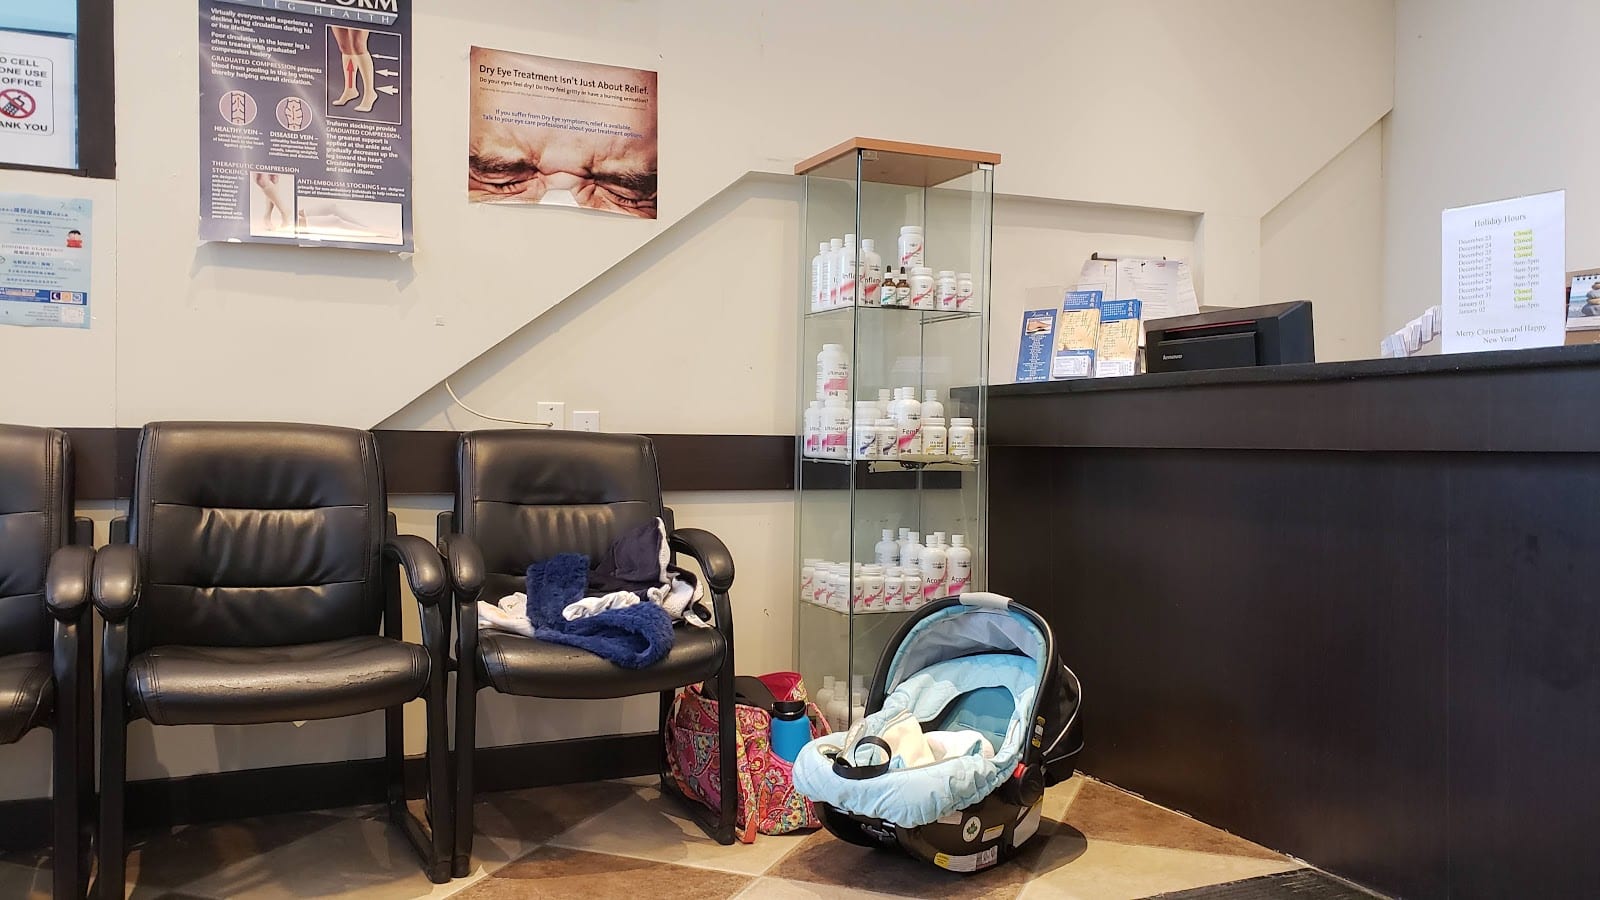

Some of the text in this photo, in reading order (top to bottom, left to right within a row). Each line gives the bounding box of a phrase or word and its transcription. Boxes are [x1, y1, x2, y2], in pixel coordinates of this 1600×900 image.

[211, 7, 235, 18] Virtually
[237, 12, 264, 21] everyone
[277, 18, 308, 27] experience
[314, 6, 389, 24] HEALTH
[211, 14, 232, 23] decline
[241, 18, 250, 27] leg
[252, 20, 282, 30] circulation
[284, 24, 302, 34] during
[231, 24, 255, 33] lifetime.
[227, 34, 257, 43] circulation
[295, 42, 304, 50] leg
[229, 40, 250, 49] treated
[267, 46, 296, 54] graduated
[211, 46, 248, 55] compression
[11, 58, 39, 67] CELL
[212, 55, 250, 65] GRADUATED
[252, 60, 296, 70] COMPRESSION
[212, 68, 235, 78] thereby
[236, 71, 258, 81] helping
[281, 77, 312, 86] circulation.
[246, 67, 268, 75] pooling
[288, 71, 297, 79] leg
[479, 64, 649, 94] Dry Eye Treatment Isn't Just About Relief.
[2, 77, 42, 87] OFFICE
[544, 84, 555, 93] they
[567, 88, 580, 96] gritty
[604, 92, 622, 101] burning
[326, 126, 359, 135] GRADUATED
[350, 122, 375, 131] stockings
[537, 121, 568, 129] professional
[598, 127, 622, 136] treatment
[212, 161, 299, 173] THERAPEUTIC COMPRESSION
[297, 179, 345, 187] ANTI-EMBOLISM
[1475, 215, 1526, 227] Holiday Hours
[1477, 327, 1509, 336] Christmas
[1524, 324, 1546, 332] Happy
